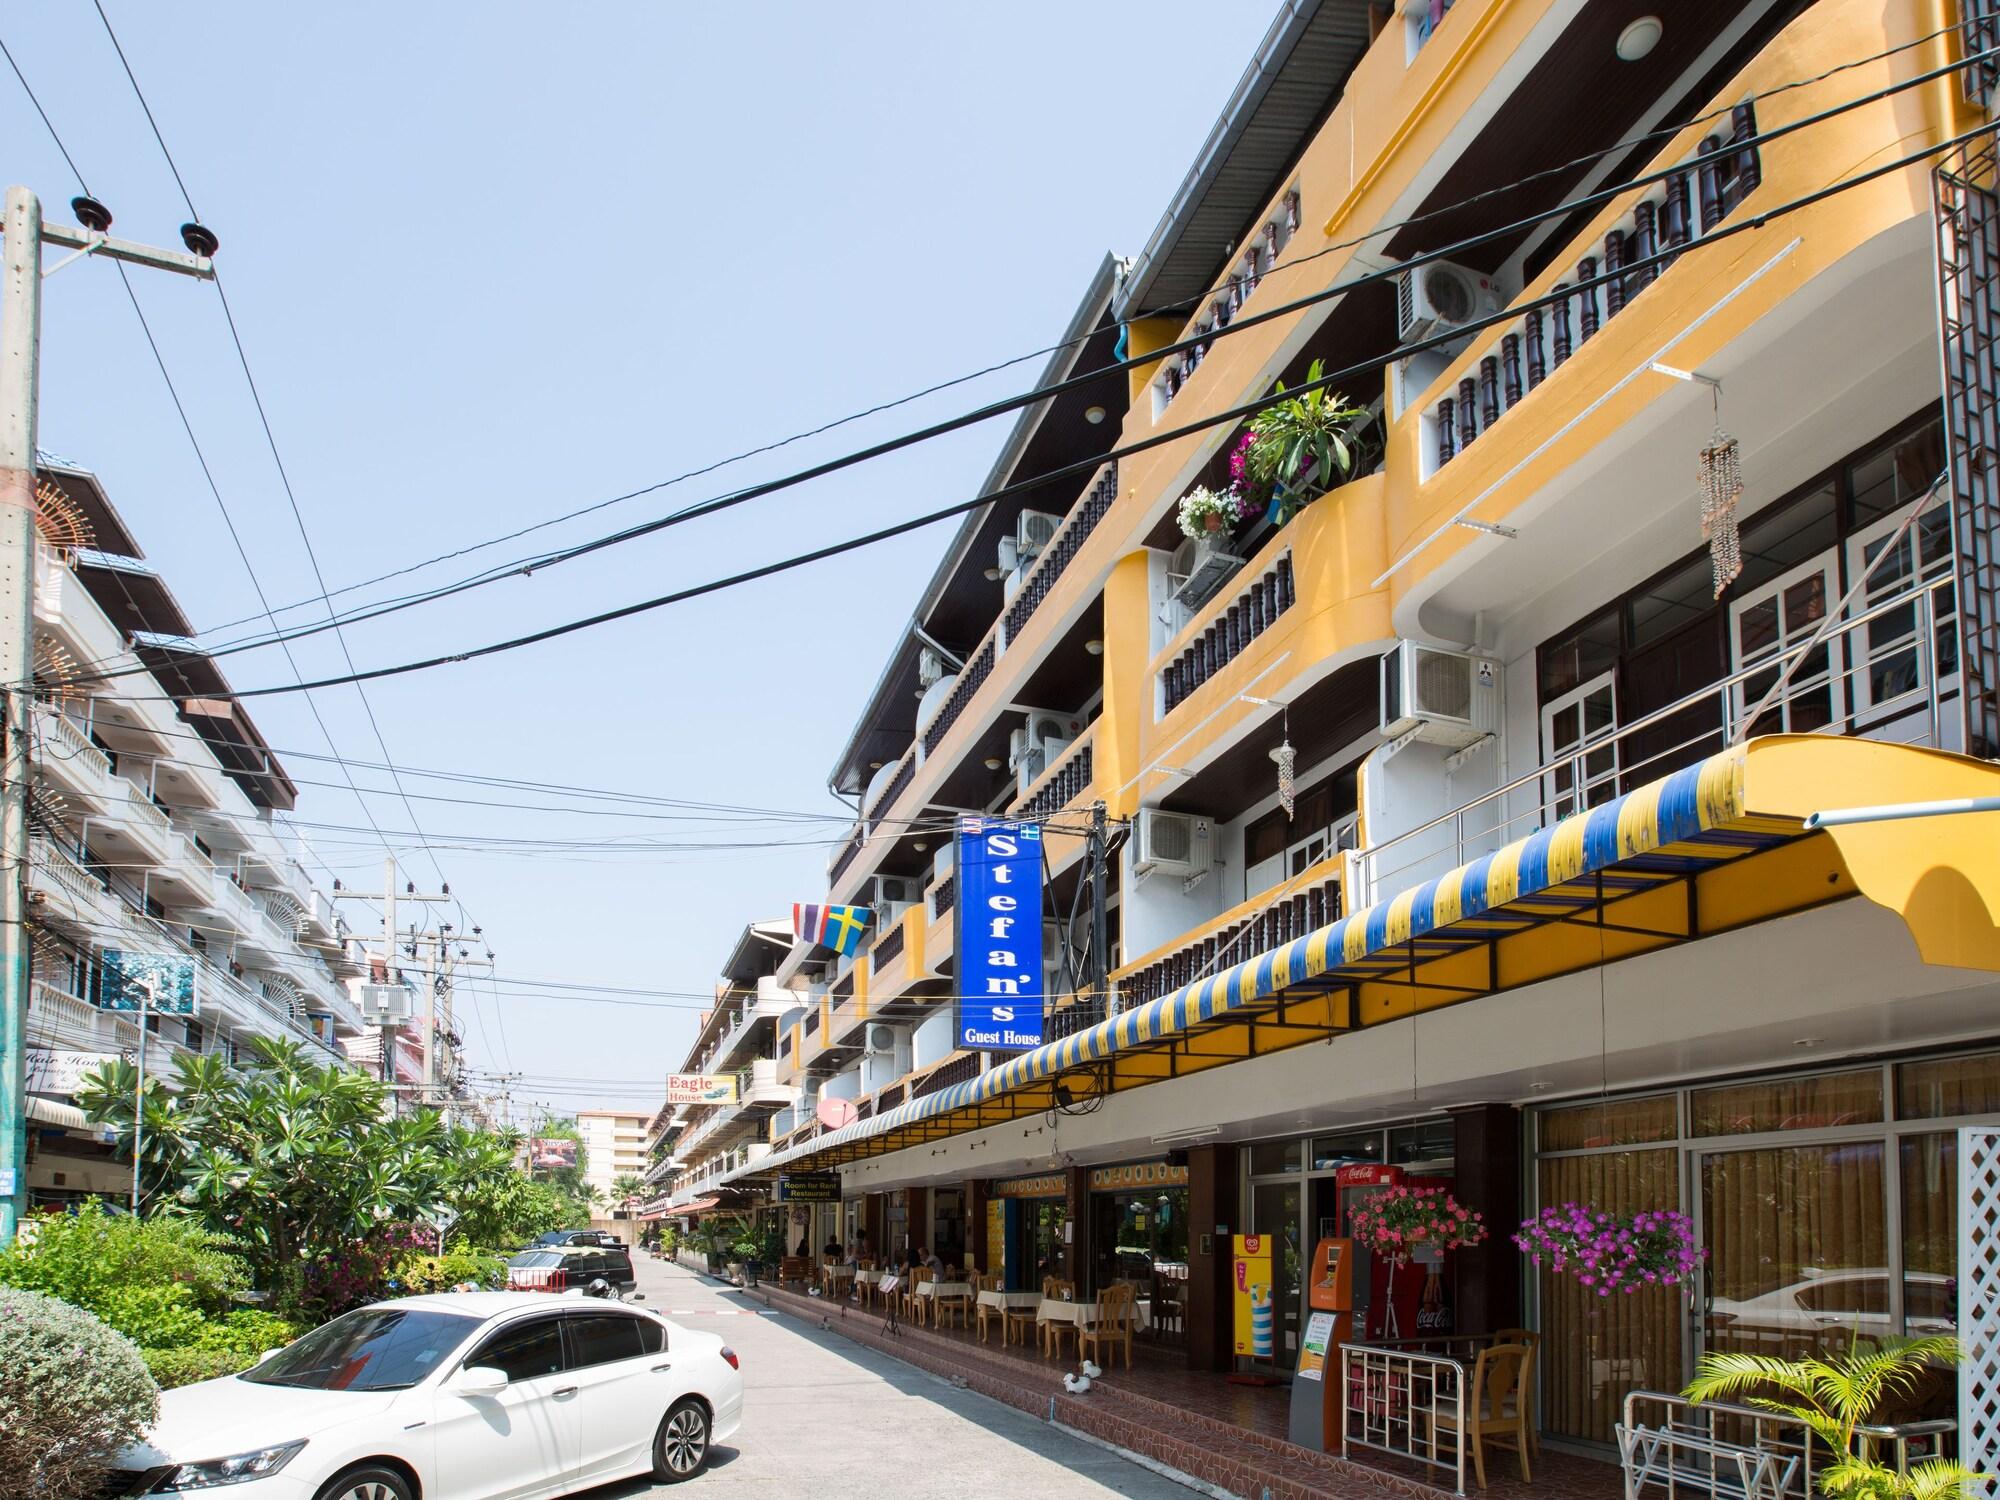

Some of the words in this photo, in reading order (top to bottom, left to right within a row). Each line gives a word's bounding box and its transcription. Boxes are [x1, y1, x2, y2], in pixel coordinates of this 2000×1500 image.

[986, 834, 1031, 1022] Stefan's
[965, 1028, 1000, 1044] Guest
[1003, 1030, 1041, 1046] House
[669, 1076, 713, 1093] Eagle
[669, 1092, 703, 1103] House
